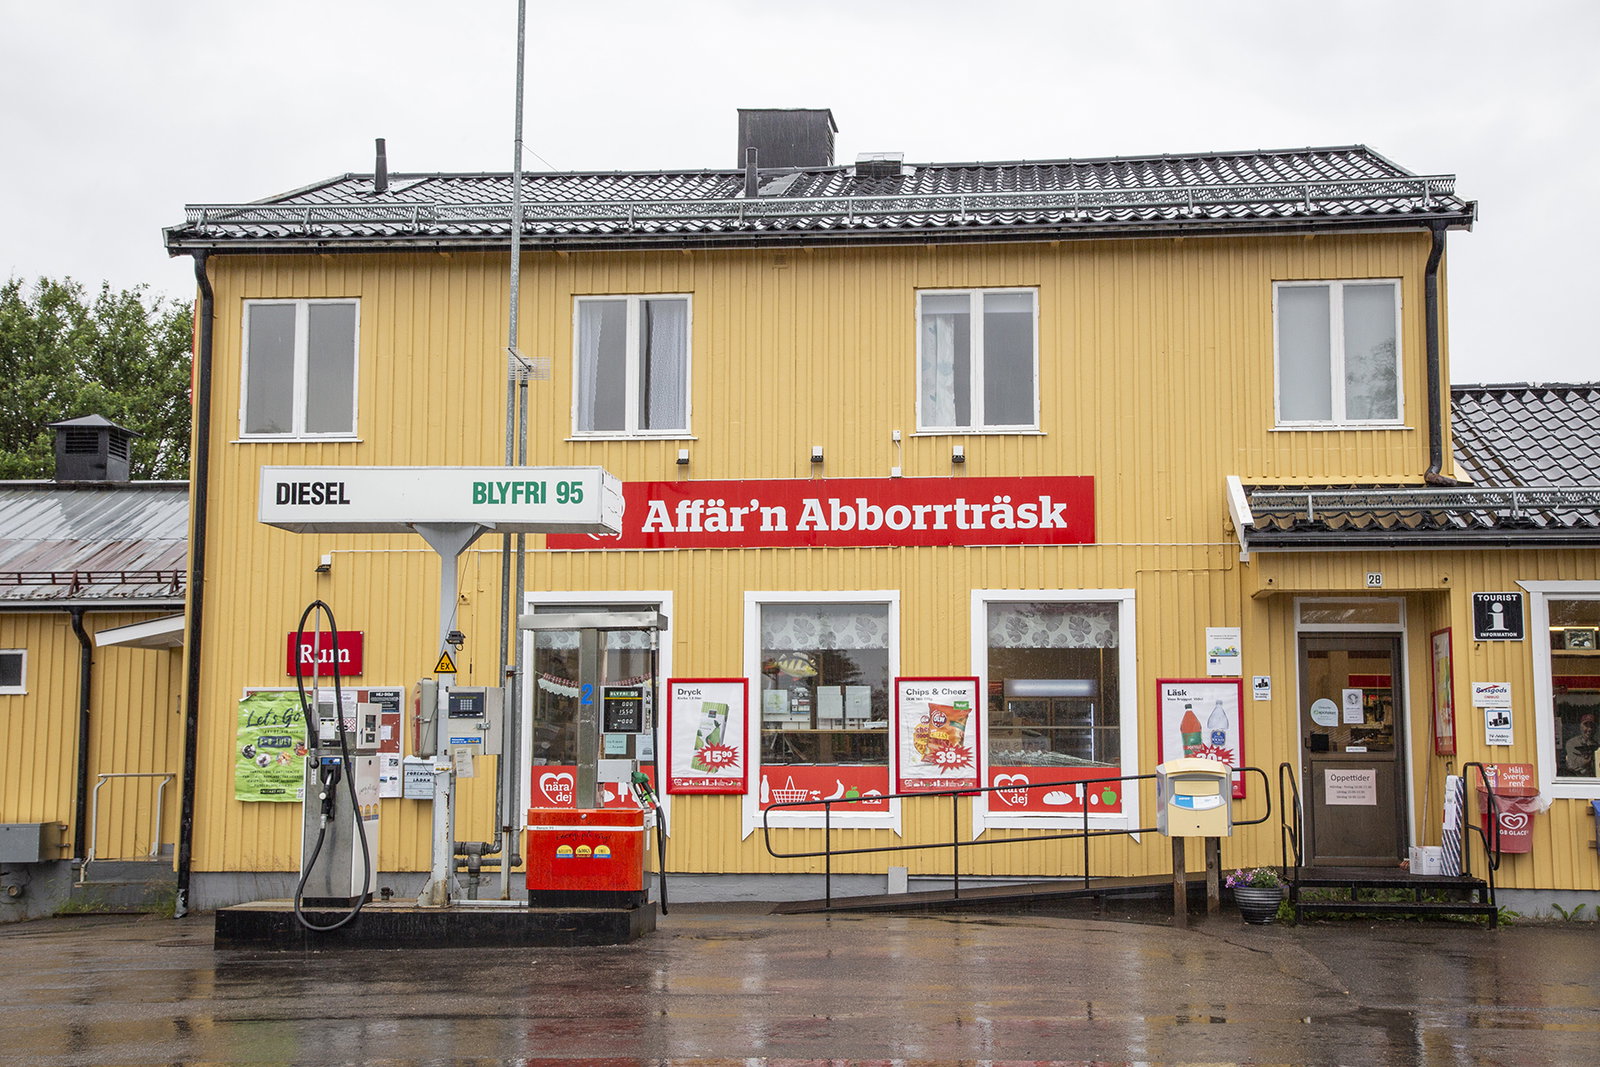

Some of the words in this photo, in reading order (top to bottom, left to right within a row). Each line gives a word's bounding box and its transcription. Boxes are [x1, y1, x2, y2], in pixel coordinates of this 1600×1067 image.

[276, 482, 350, 505] DIESEL
[472, 481, 547, 505] BLYFRI
[556, 481, 584, 504] 95
[641, 498, 788, 532] Affär'n
[796, 495, 1067, 531] Abborrträsk
[1368, 574, 1381, 584] 28
[581, 683, 593, 705] 2
[677, 688, 702, 697] Dryck
[906, 688, 930, 697] Chips
[932, 688, 939, 696] &
[246, 708, 279, 728] Let's
[282, 708, 301, 728] Go
[704, 751, 722, 762] 15
[935, 751, 967, 763] 39:-
[1330, 773, 1370, 782] Öppettider
[1503, 773, 1530, 781] Sverige
[545, 781, 570, 791] nära
[555, 791, 572, 805] dej
[1011, 793, 1028, 806] dej
